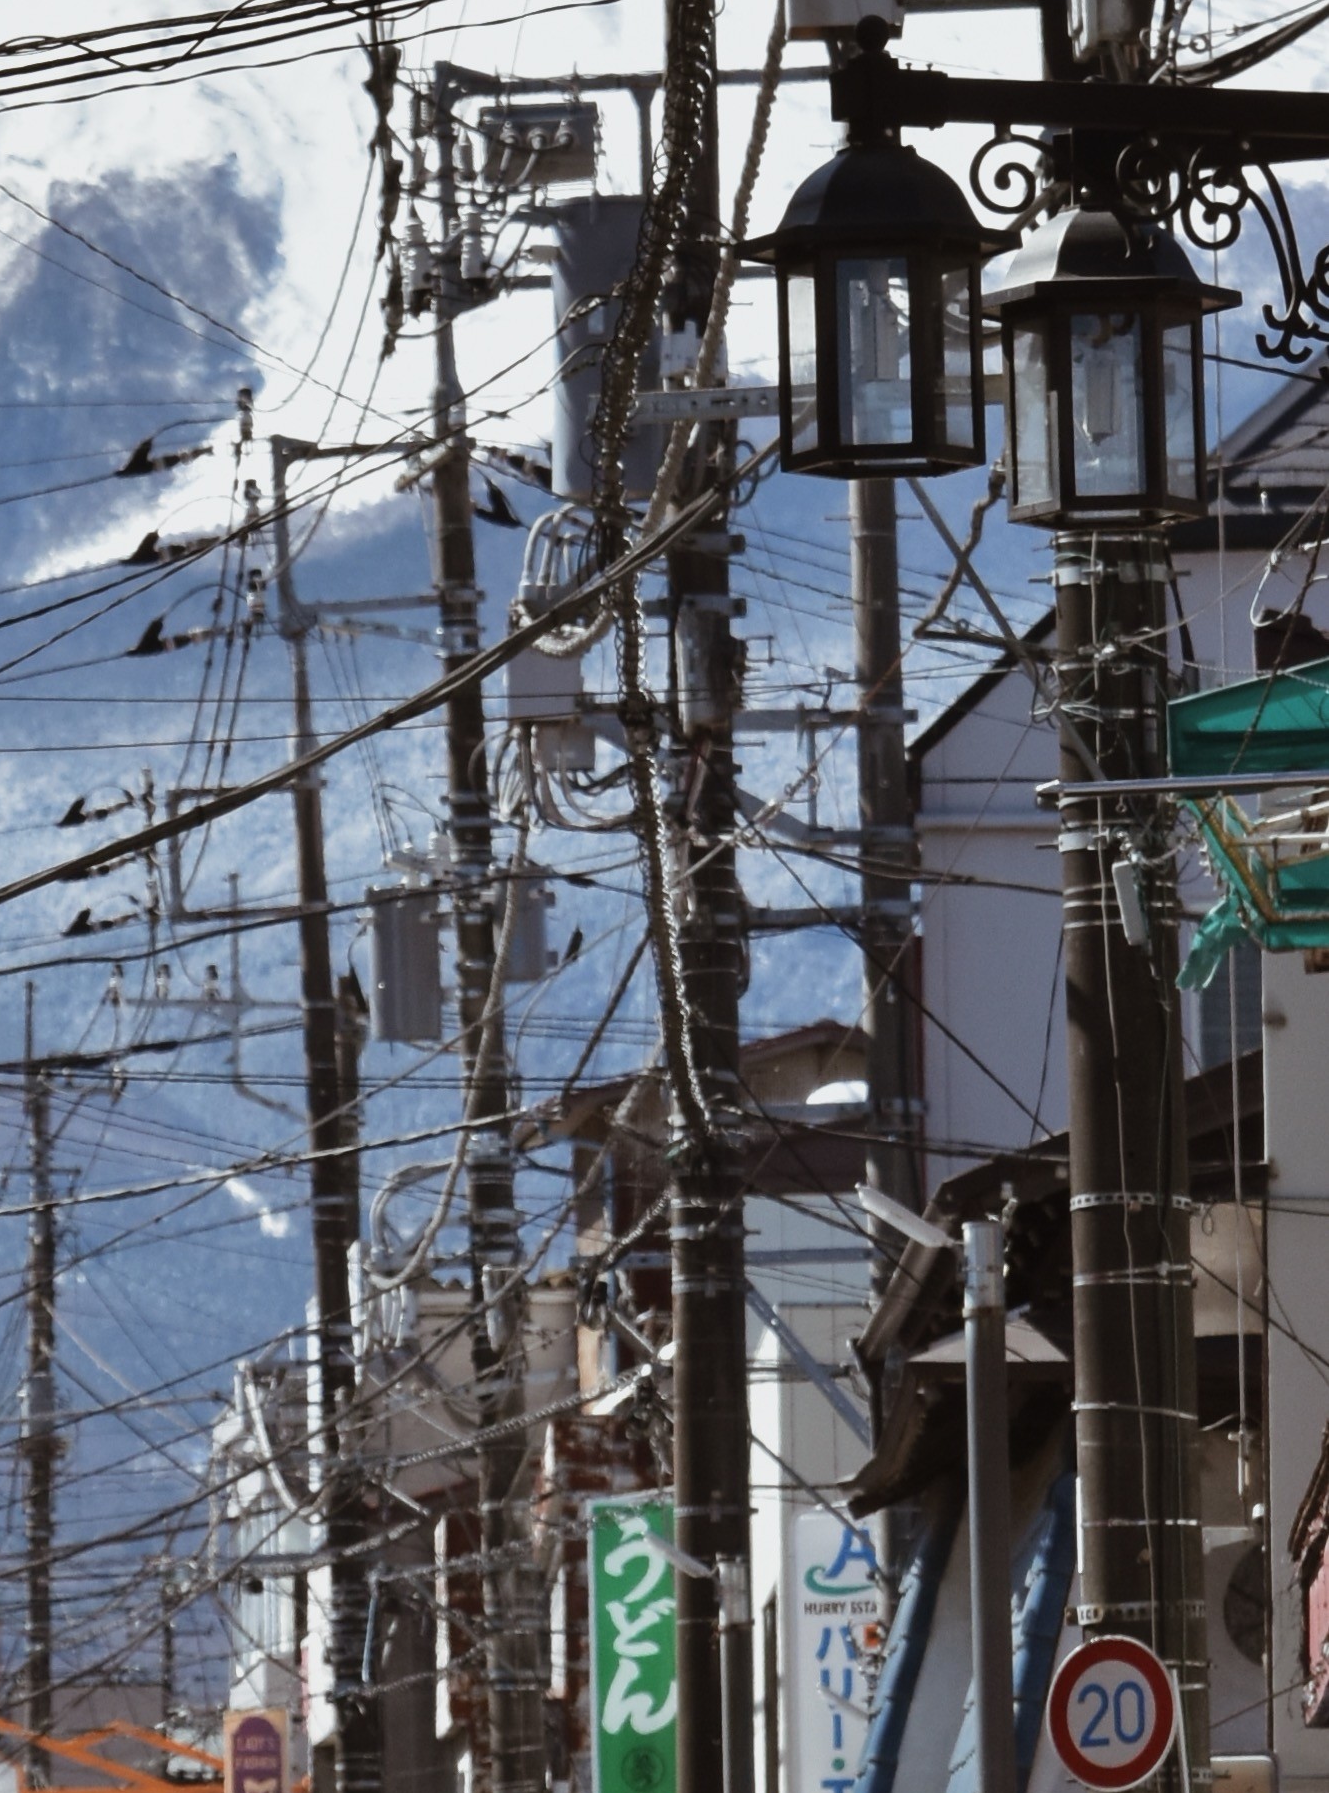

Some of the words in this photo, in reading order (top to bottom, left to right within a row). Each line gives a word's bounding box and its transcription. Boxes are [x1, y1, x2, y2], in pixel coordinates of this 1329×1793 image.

[602, 1515, 676, 1735] うどん
[1077, 1681, 1145, 1748] 20
